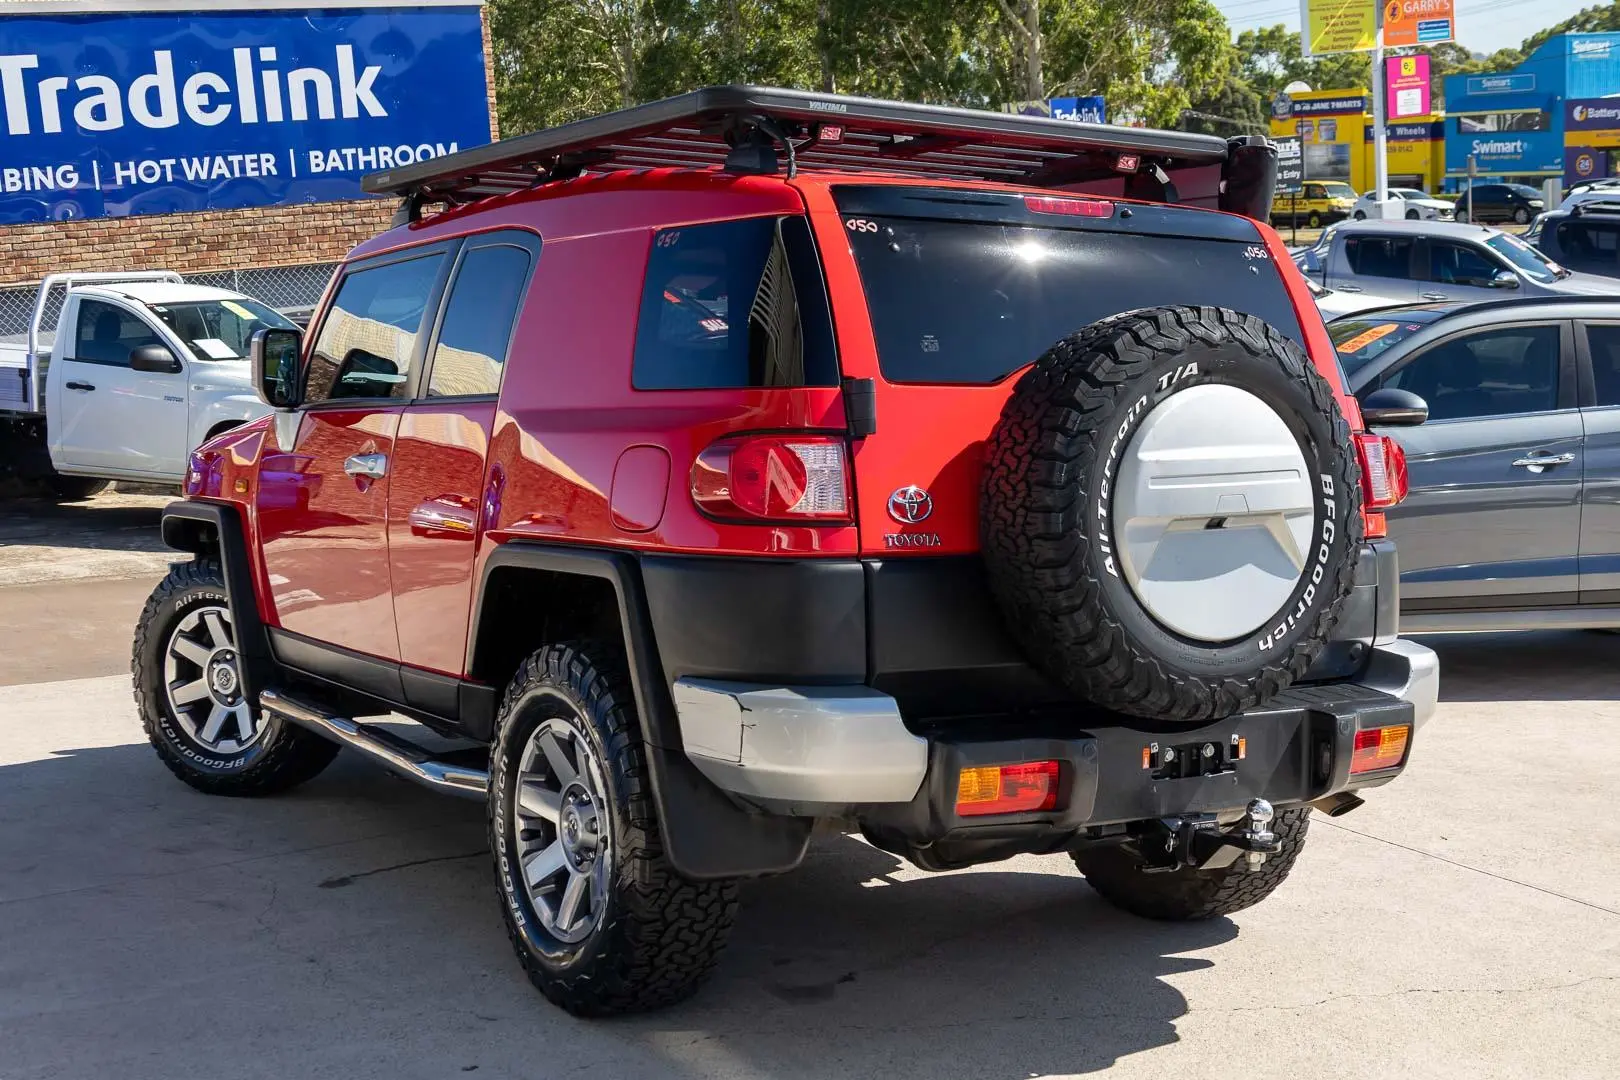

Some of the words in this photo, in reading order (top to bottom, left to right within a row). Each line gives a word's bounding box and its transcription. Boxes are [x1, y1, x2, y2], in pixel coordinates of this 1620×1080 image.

[0, 45, 388, 135] Tradelink
[809, 101, 847, 112] YAKIMA
[1395, 126, 1426, 136] Wheels
[1472, 139, 1522, 153] Swimart
[0, 165, 79, 192] BING
[115, 159, 175, 185] HOT
[181, 153, 277, 181] WATER
[310, 142, 458, 172] BATHROOM
[1158, 361, 1200, 389] T/A
[1099, 395, 1149, 578] All-Terrain
[884, 533, 941, 547] TOYOTA
[1258, 473, 1335, 652] BFGoodrich
